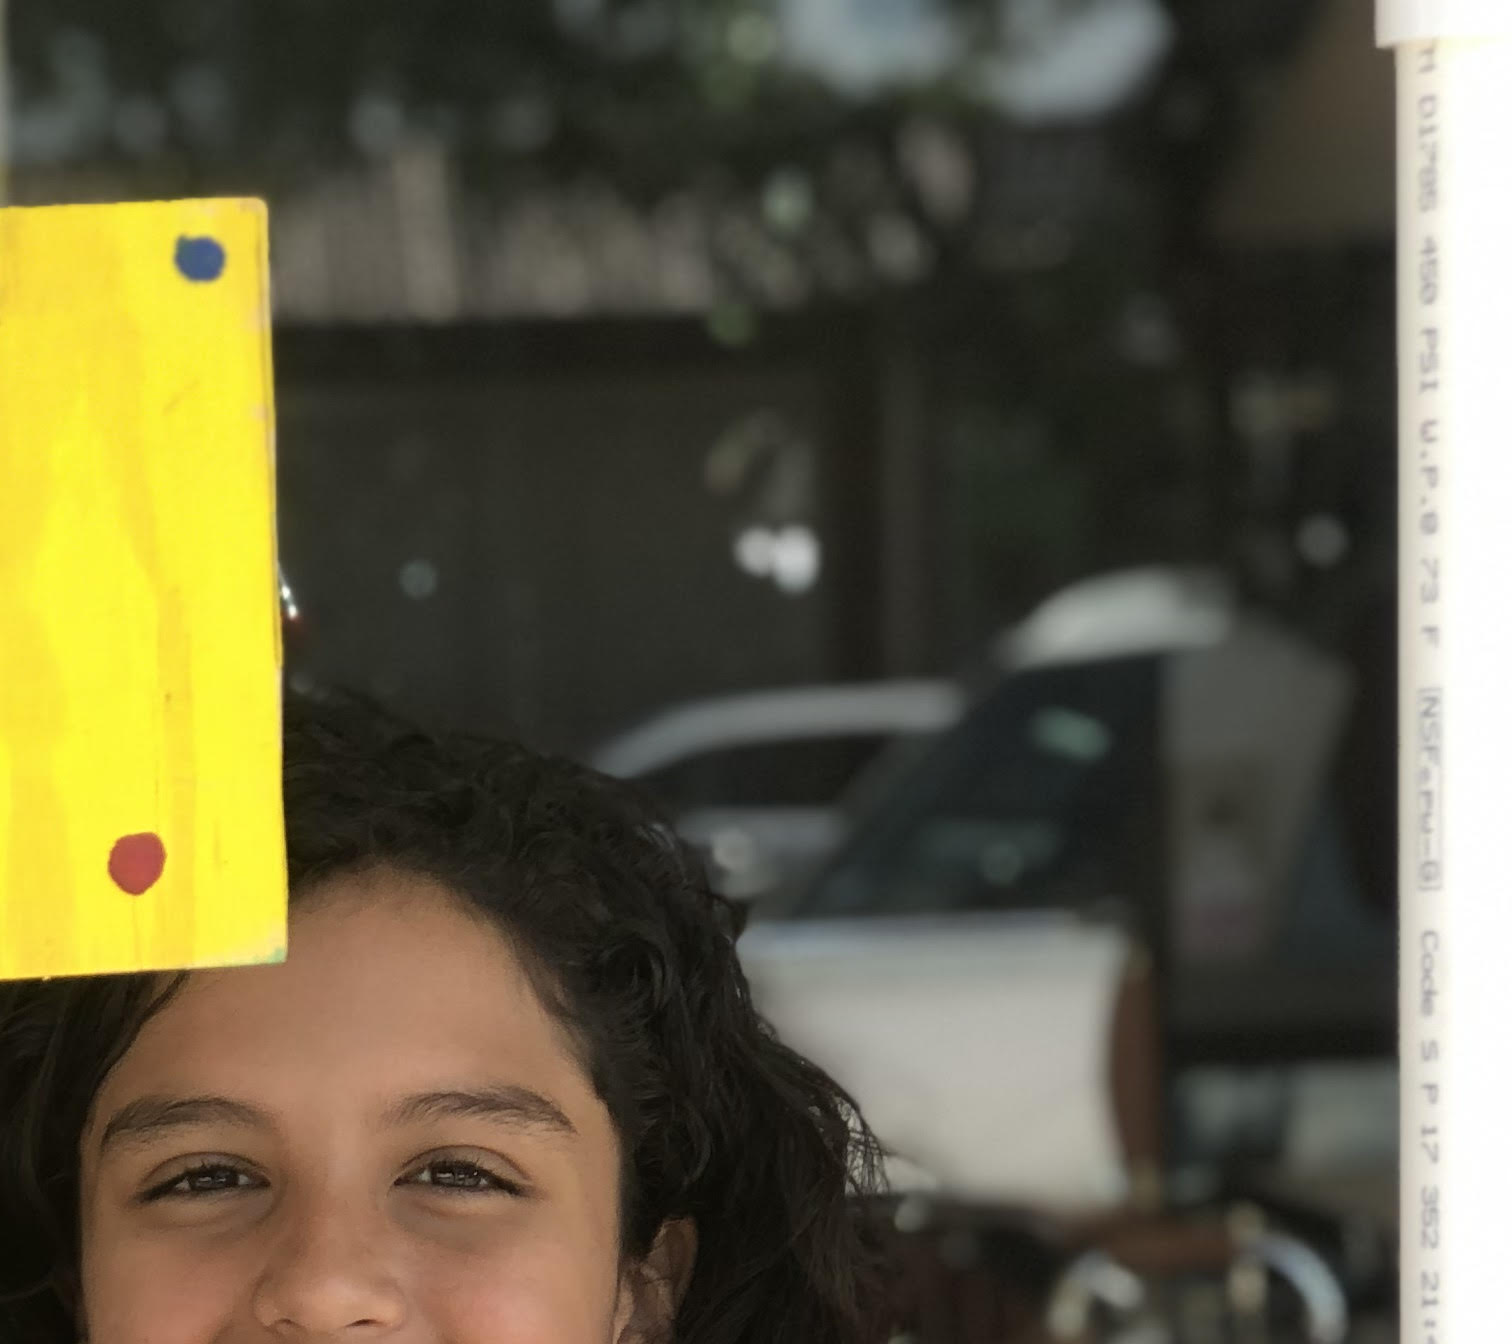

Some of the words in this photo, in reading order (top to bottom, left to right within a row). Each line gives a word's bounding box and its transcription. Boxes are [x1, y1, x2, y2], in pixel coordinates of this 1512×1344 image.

[1418, 236, 1441, 305] 450
[1419, 328, 1441, 393] PSI
[1420, 930, 1443, 1017] Code
